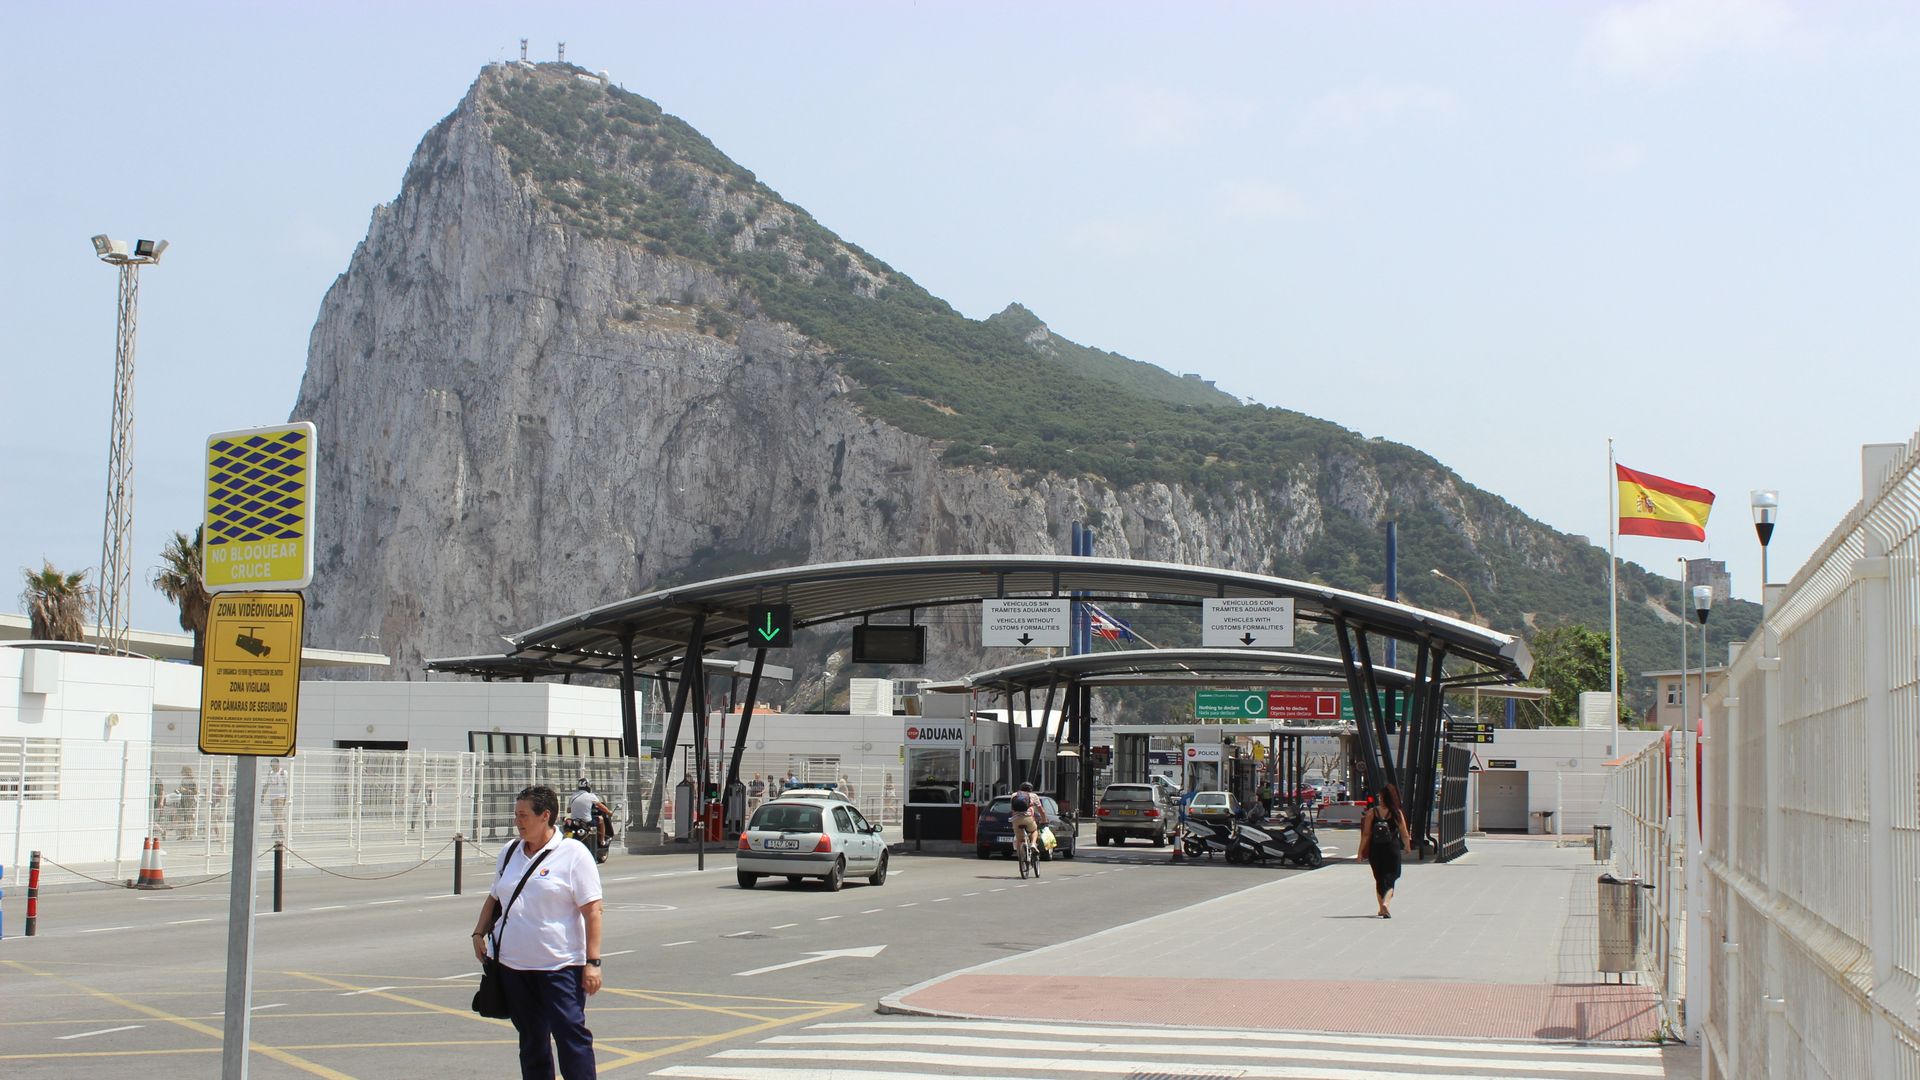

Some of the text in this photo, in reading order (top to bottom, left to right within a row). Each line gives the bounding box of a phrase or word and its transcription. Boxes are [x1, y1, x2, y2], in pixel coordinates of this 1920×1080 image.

[213, 543, 296, 562] NO BLOQUEAR
[232, 563, 271, 578] CRUCE
[217, 603, 293, 617] ZONA VIDEOVIGILADA
[230, 682, 270, 693] ZONA VIGILADA
[210, 698, 287, 712] POR CÁMARAS DE SEGURIDAD
[919, 728, 962, 740] ADUANA
